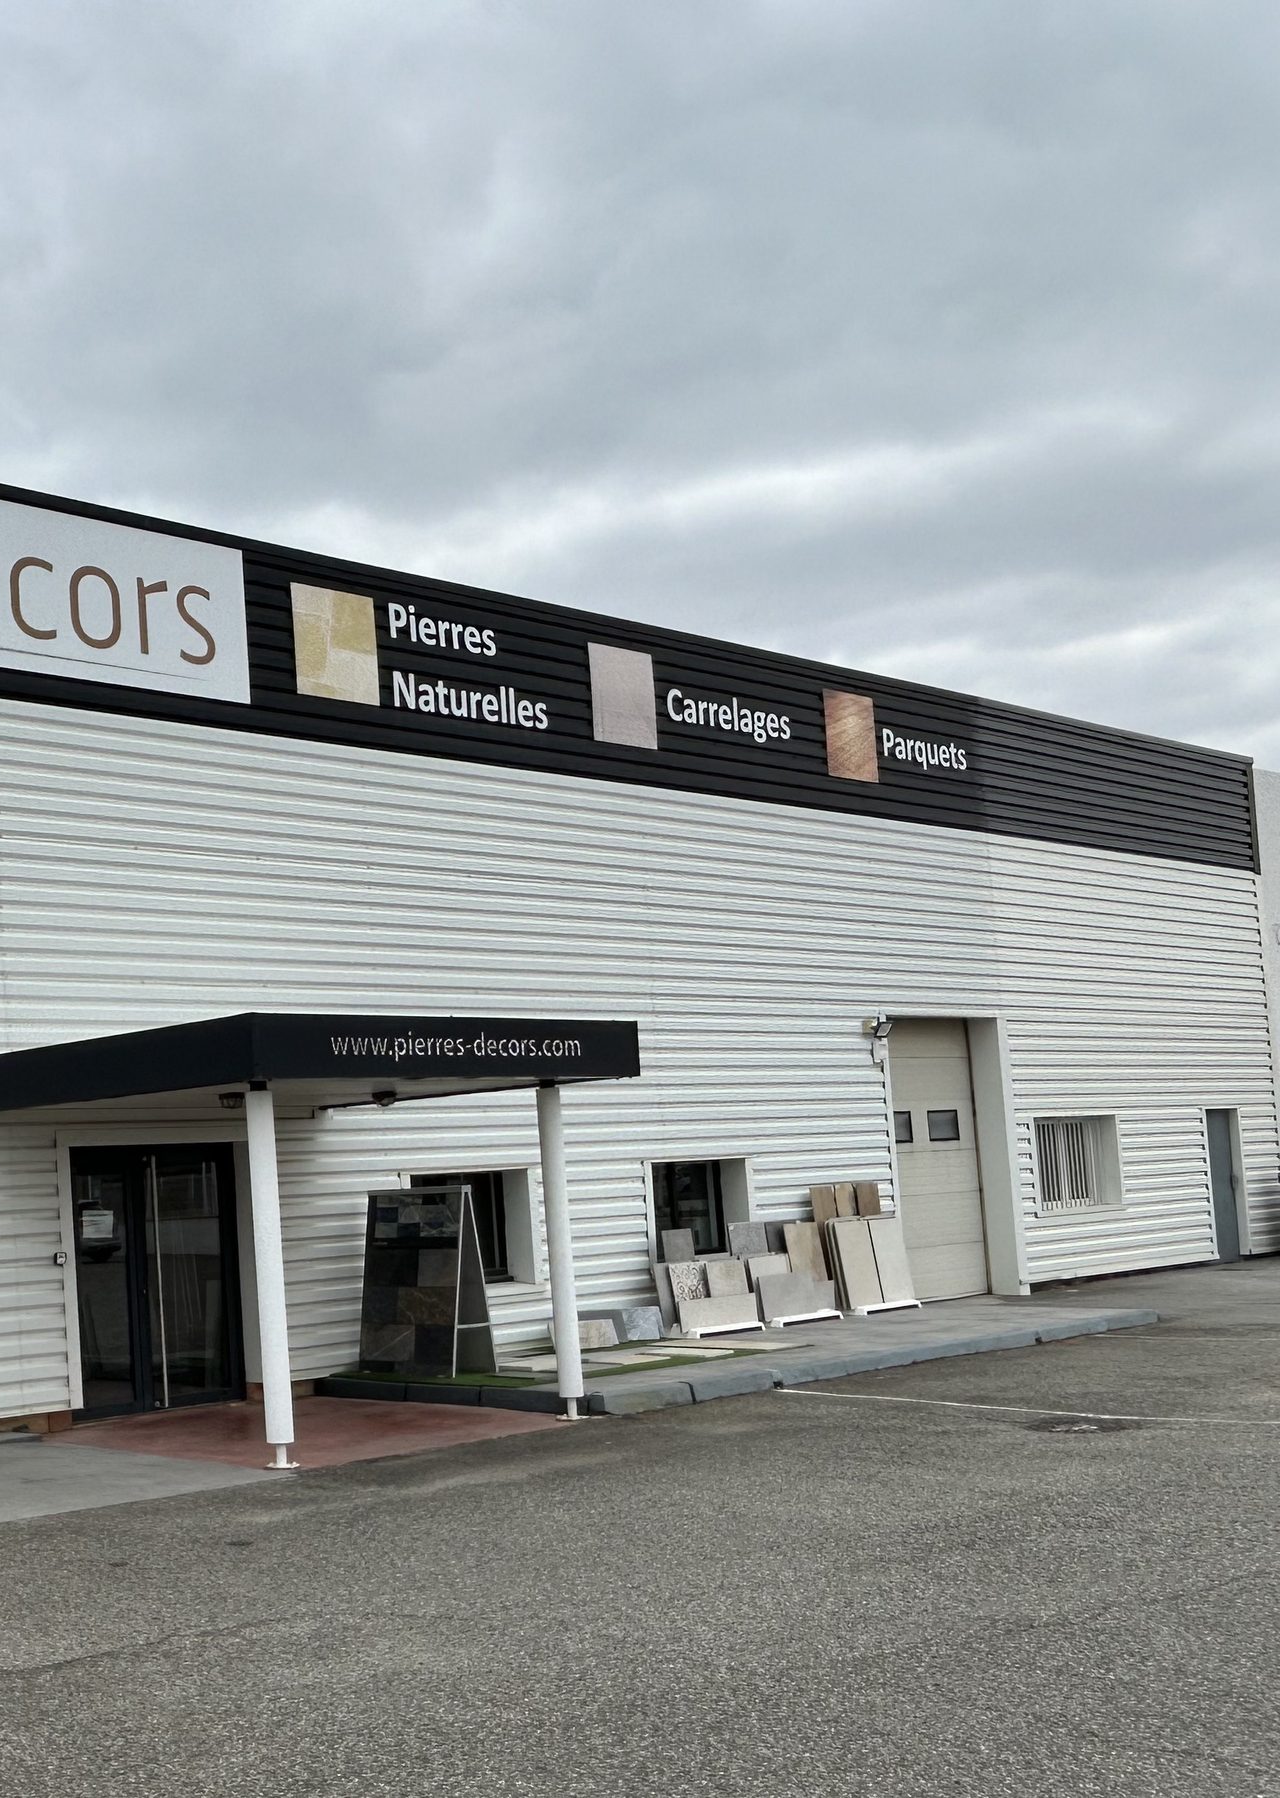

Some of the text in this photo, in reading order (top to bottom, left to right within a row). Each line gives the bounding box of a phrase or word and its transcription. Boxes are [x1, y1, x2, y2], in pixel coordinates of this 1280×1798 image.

[387, 603, 496, 657] Pierres
[393, 671, 548, 730] Naturelles
[666, 689, 791, 743] Carrelages
[881, 728, 967, 771] Parquets
[330, 1031, 582, 1062] www.pierres-decors.com
